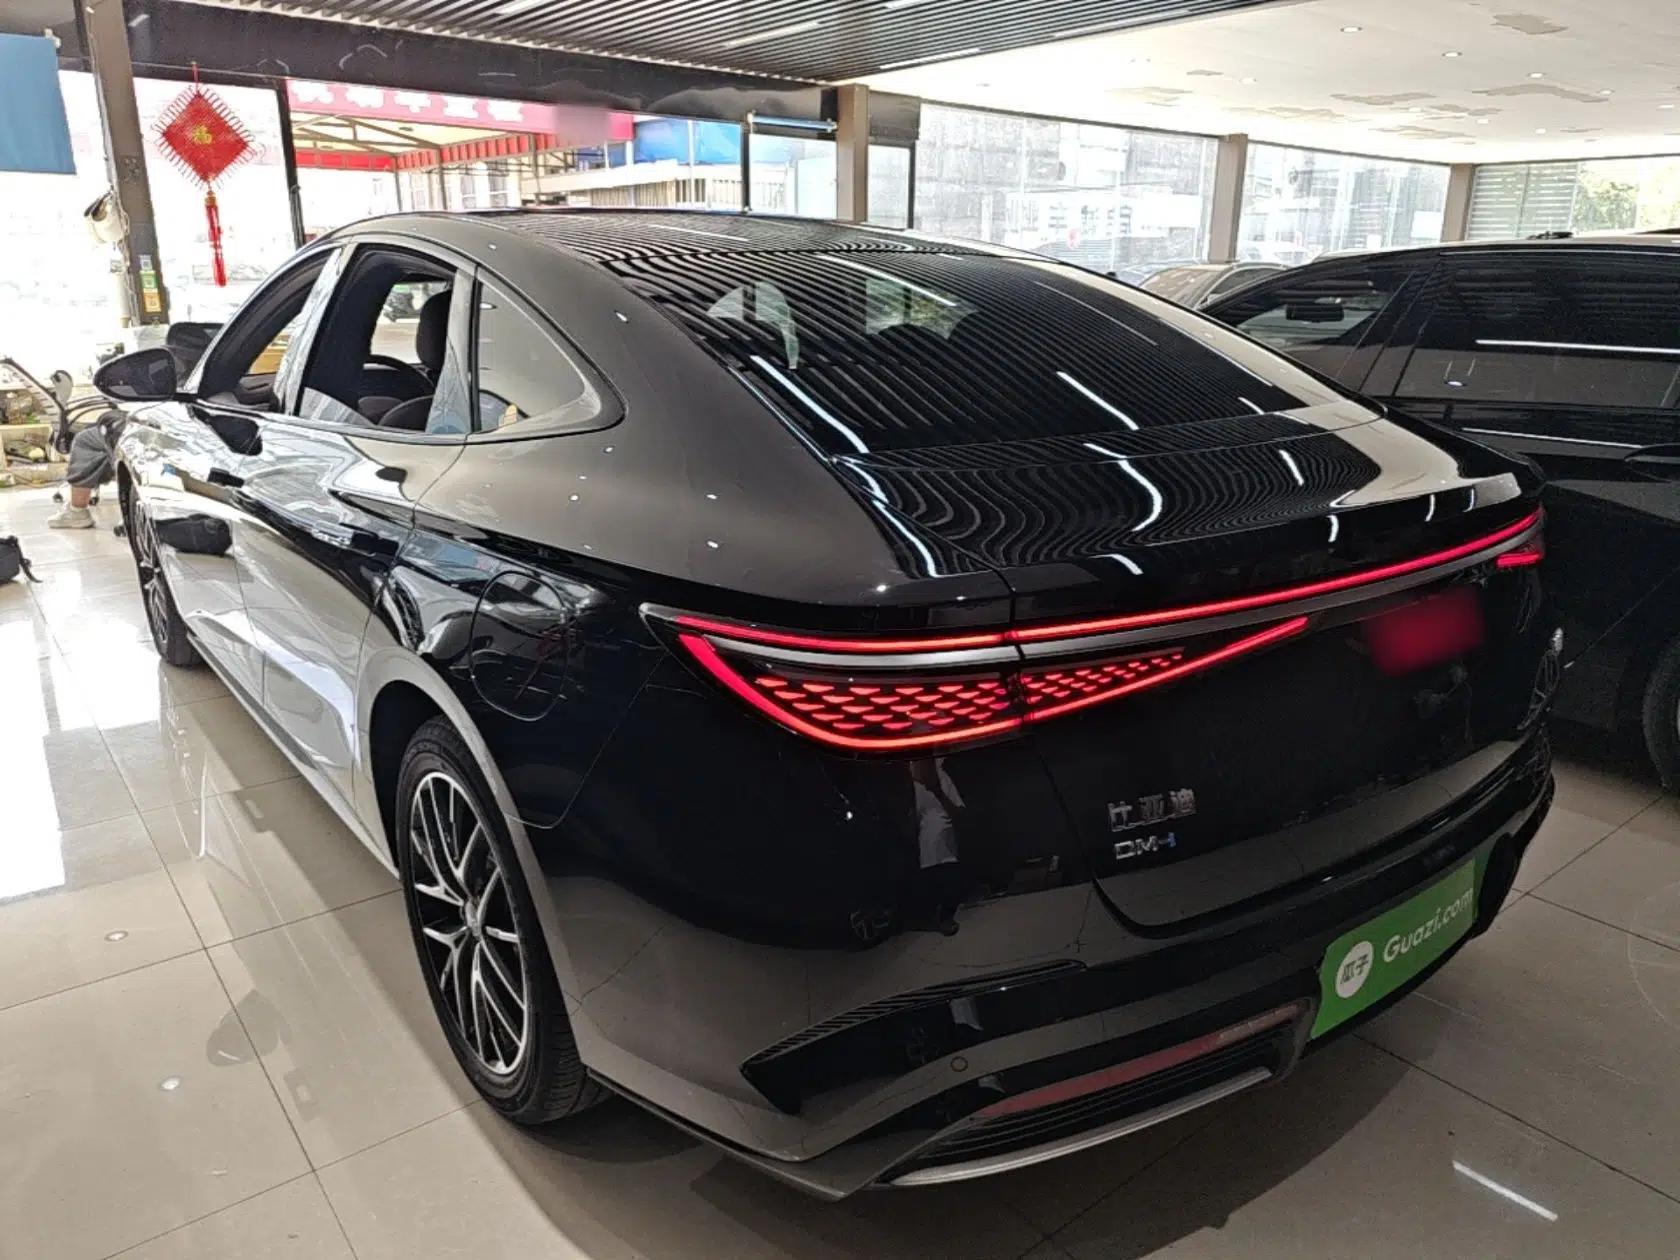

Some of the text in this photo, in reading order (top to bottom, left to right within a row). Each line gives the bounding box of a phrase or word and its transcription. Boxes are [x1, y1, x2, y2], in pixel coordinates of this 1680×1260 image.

[1107, 788, 1197, 832] 比亚迪
[1383, 887, 1474, 963] Guazi.com
[1340, 954, 1370, 985] 瓜子
